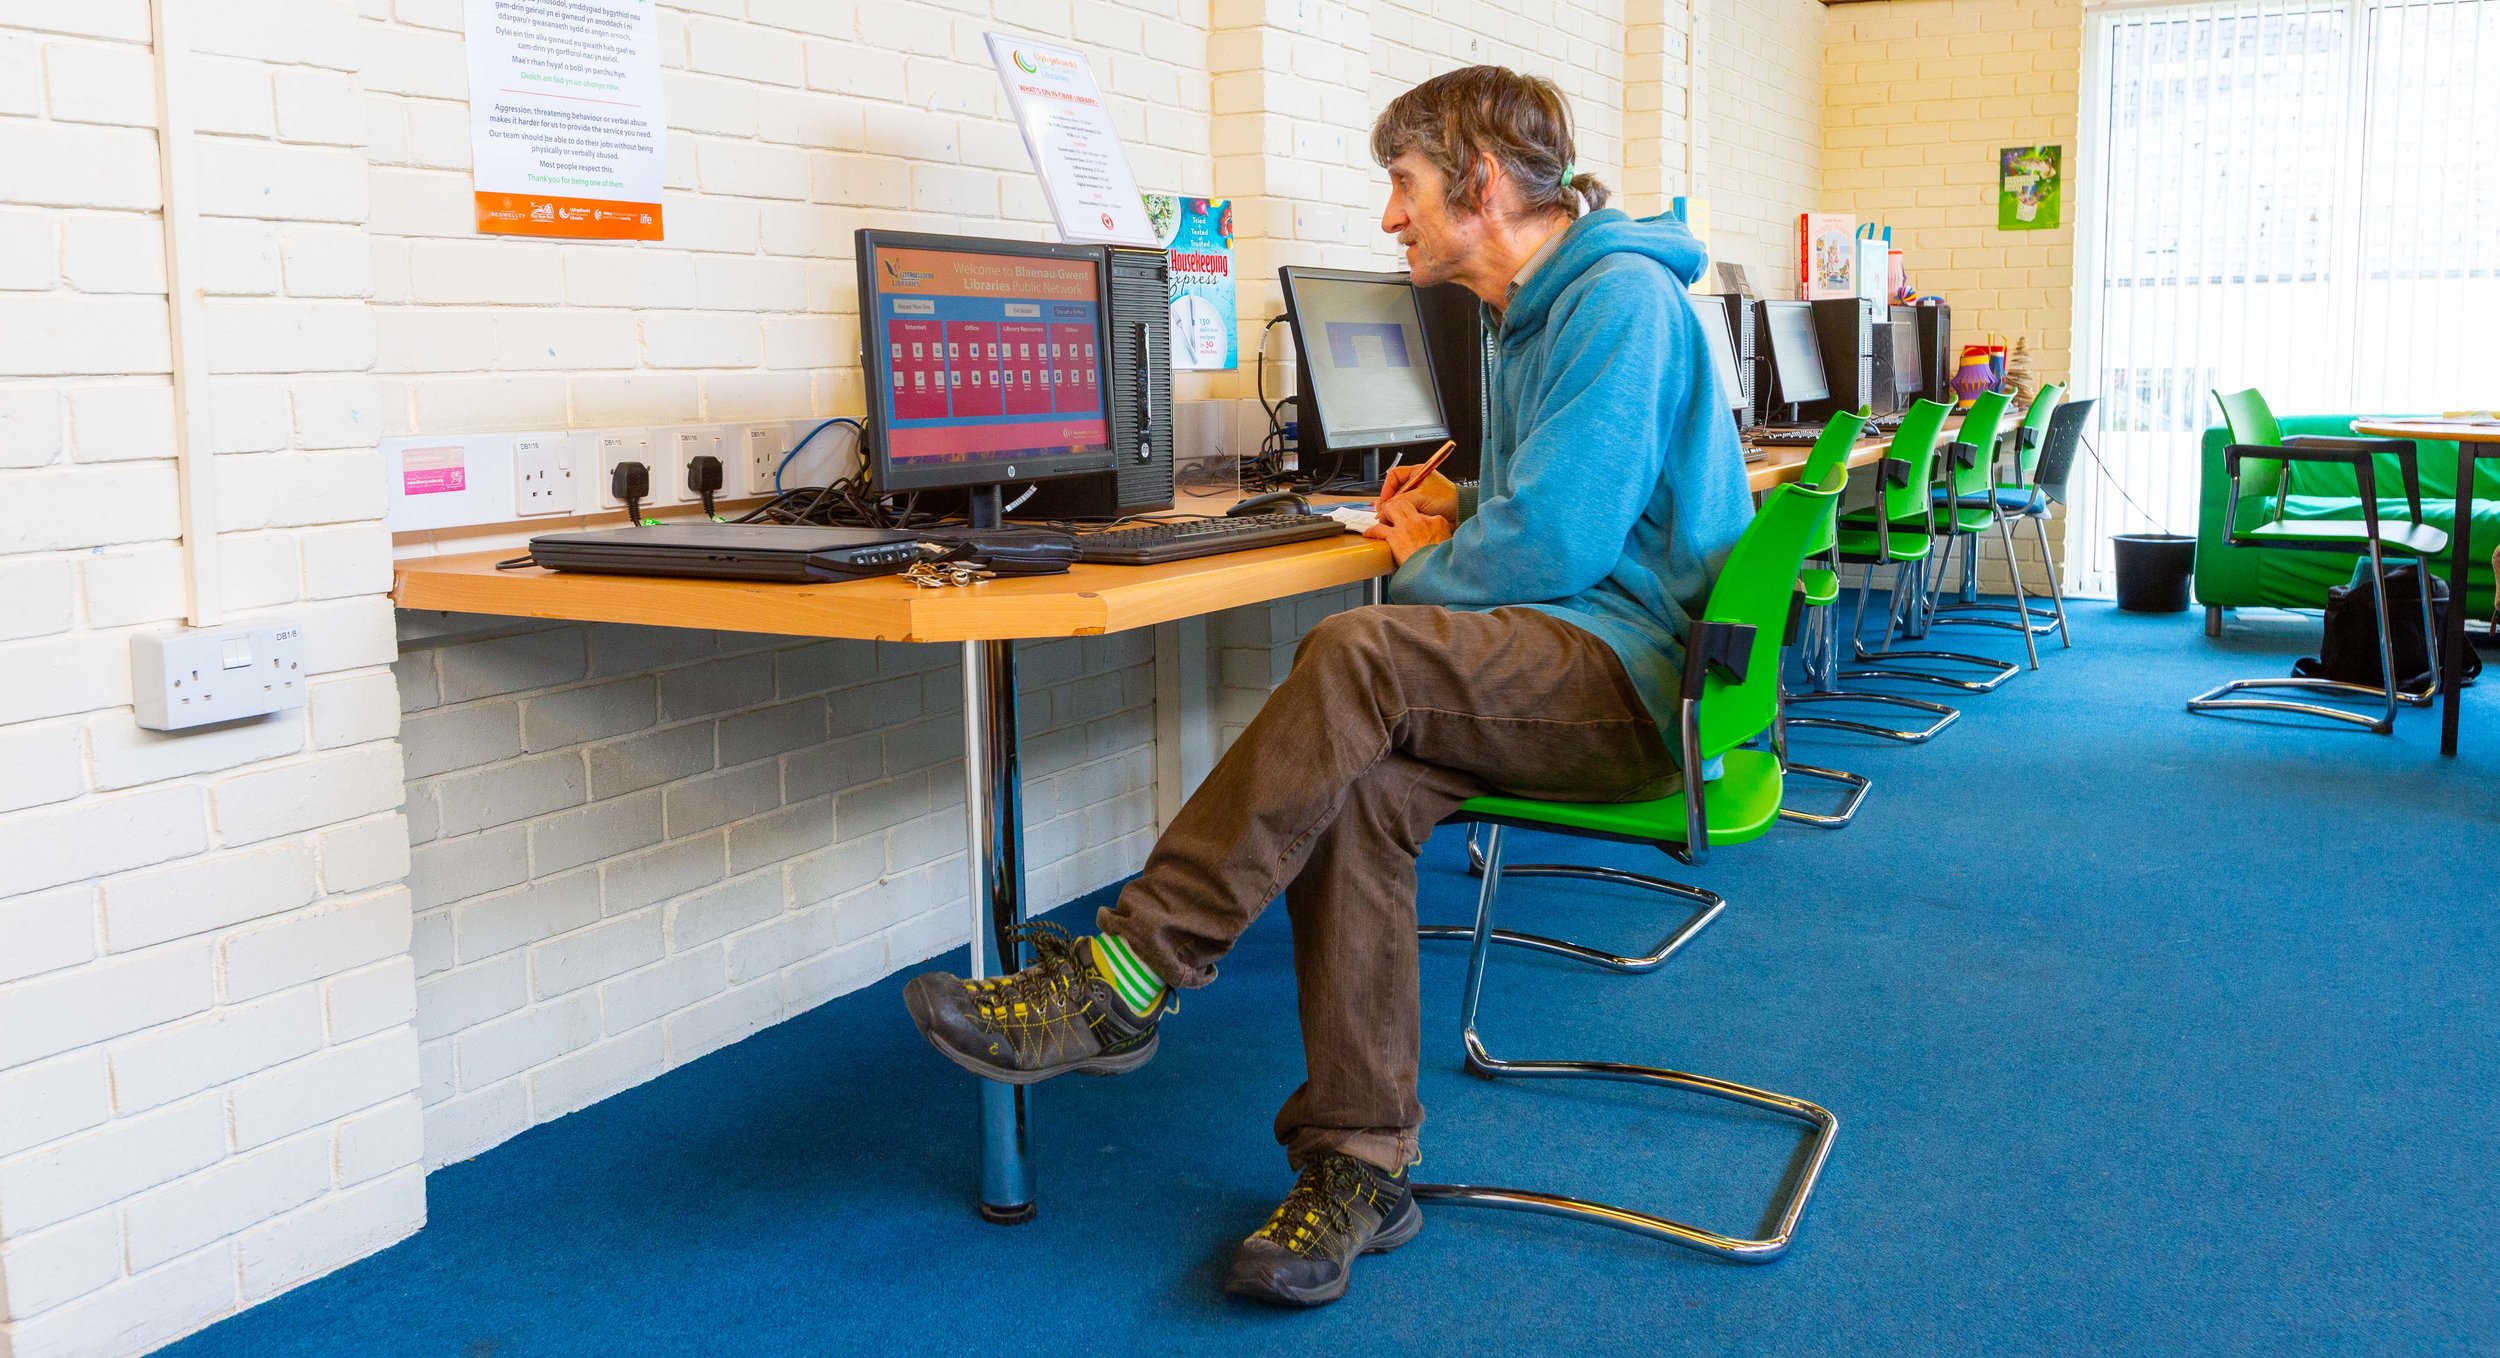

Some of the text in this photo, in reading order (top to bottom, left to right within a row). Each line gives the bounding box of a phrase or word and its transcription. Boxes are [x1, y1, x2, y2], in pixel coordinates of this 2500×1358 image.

[525, 6, 545, 14] geiriol
[561, 13, 585, 22] gwneud
[595, 19, 623, 28] anoddach
[569, 3, 601, 14] ymddygiad
[602, 8, 629, 18] bygythiol
[532, 20, 568, 30] gwasanaeth
[496, 26, 512, 36] Dylai
[548, 36, 572, 45] gwneud
[582, 42, 602, 50] gwaith
[518, 43, 546, 52] cam-drin
[556, 48, 582, 58] gorfforol
[512, 56, 529, 64] Mae'r
[546, 60, 563, 70] fwyaf
[521, 72, 541, 80] Diolch
[583, 81, 605, 89] ohonyn
[490, 115, 511, 123] makes
[518, 117, 539, 126] harder
[495, 104, 533, 115] Aggression,
[534, 108, 570, 120] threatening
[572, 112, 602, 122] behaviour
[630, 118, 647, 126] abuse
[521, 132, 543, 141] should
[545, 134, 552, 142] be
[600, 140, 612, 148] jobs
[614, 142, 637, 150] without
[638, 144, 653, 154] being
[532, 145, 562, 156] physically
[572, 150, 595, 159] verbally
[596, 152, 620, 160] abused.
[579, 164, 600, 172] respect
[602, 165, 614, 173] this.
[572, 178, 588, 186] being
[640, 213, 652, 224] life
[1170, 249, 1228, 277] Housekeeping
[954, 262, 1088, 280] Welcome to Blaenau Gwent
[964, 279, 1082, 294] Libraries Public Network
[276, 630, 297, 640] DB1/8
